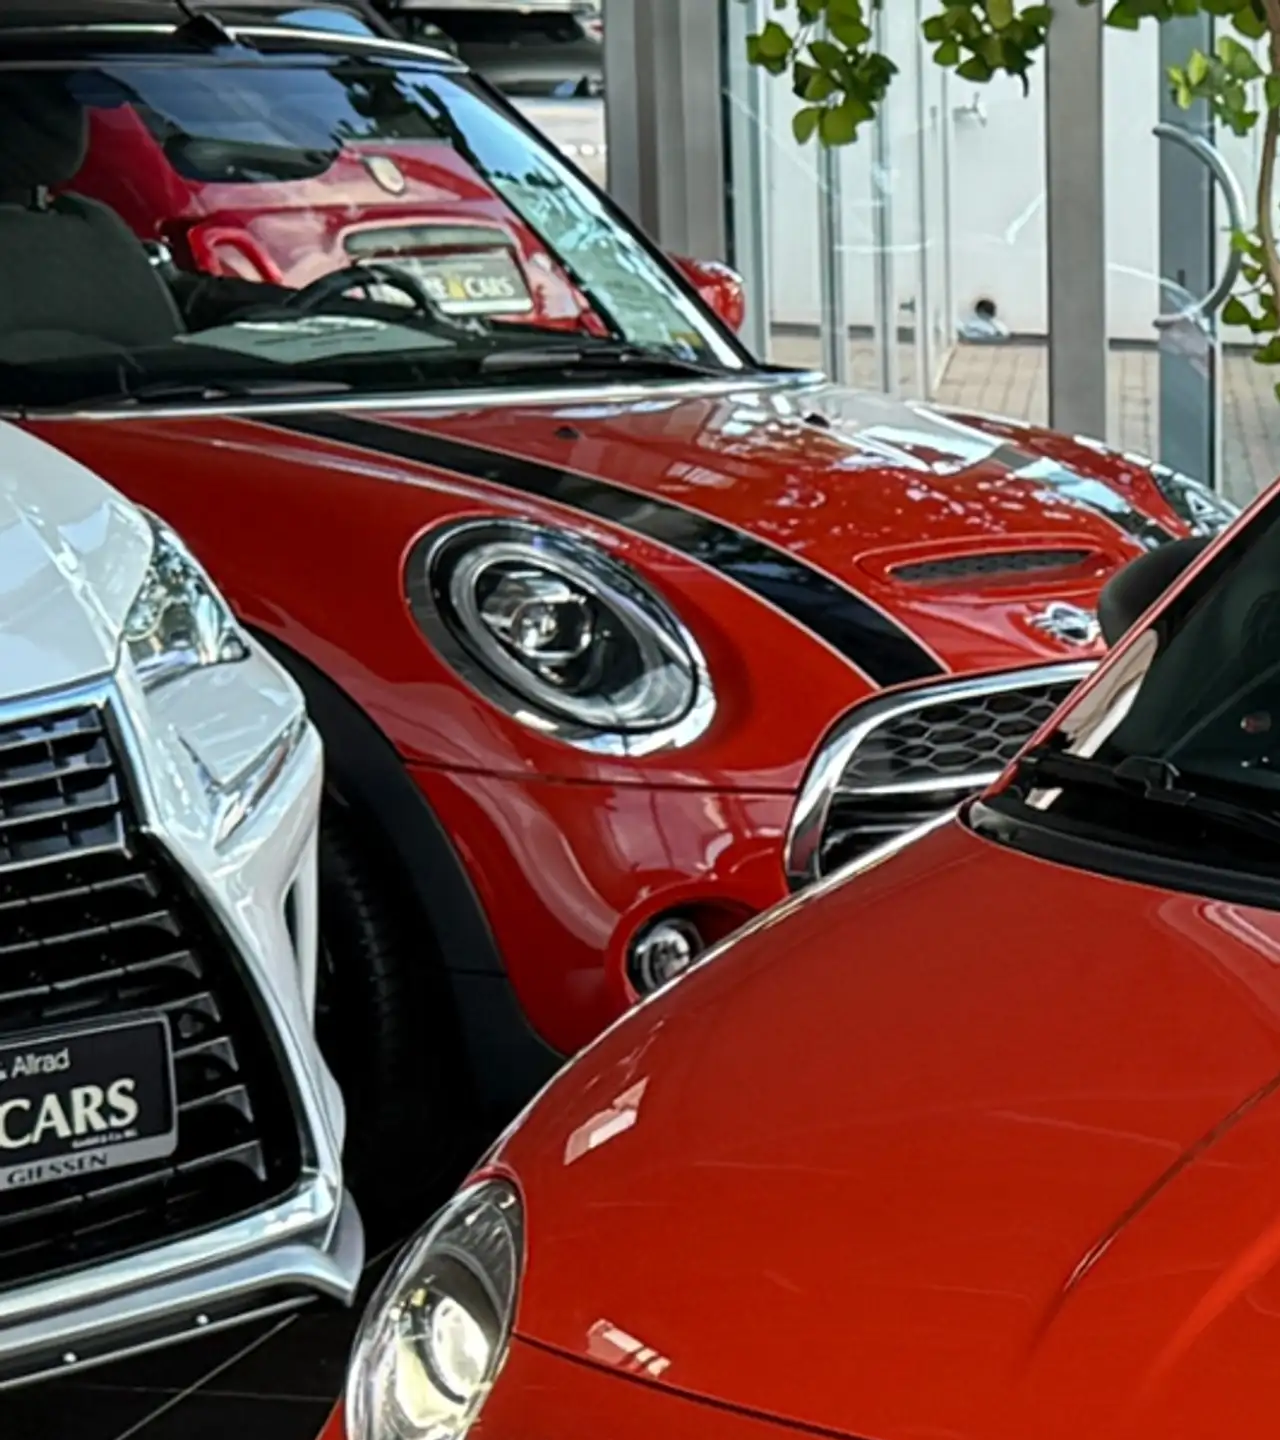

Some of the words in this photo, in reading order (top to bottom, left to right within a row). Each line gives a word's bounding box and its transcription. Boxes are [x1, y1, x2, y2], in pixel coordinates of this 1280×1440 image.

[12, 1048, 70, 1078] Allrad
[0, 1077, 139, 1149] CARS
[7, 1152, 107, 1184] GIESSEN
